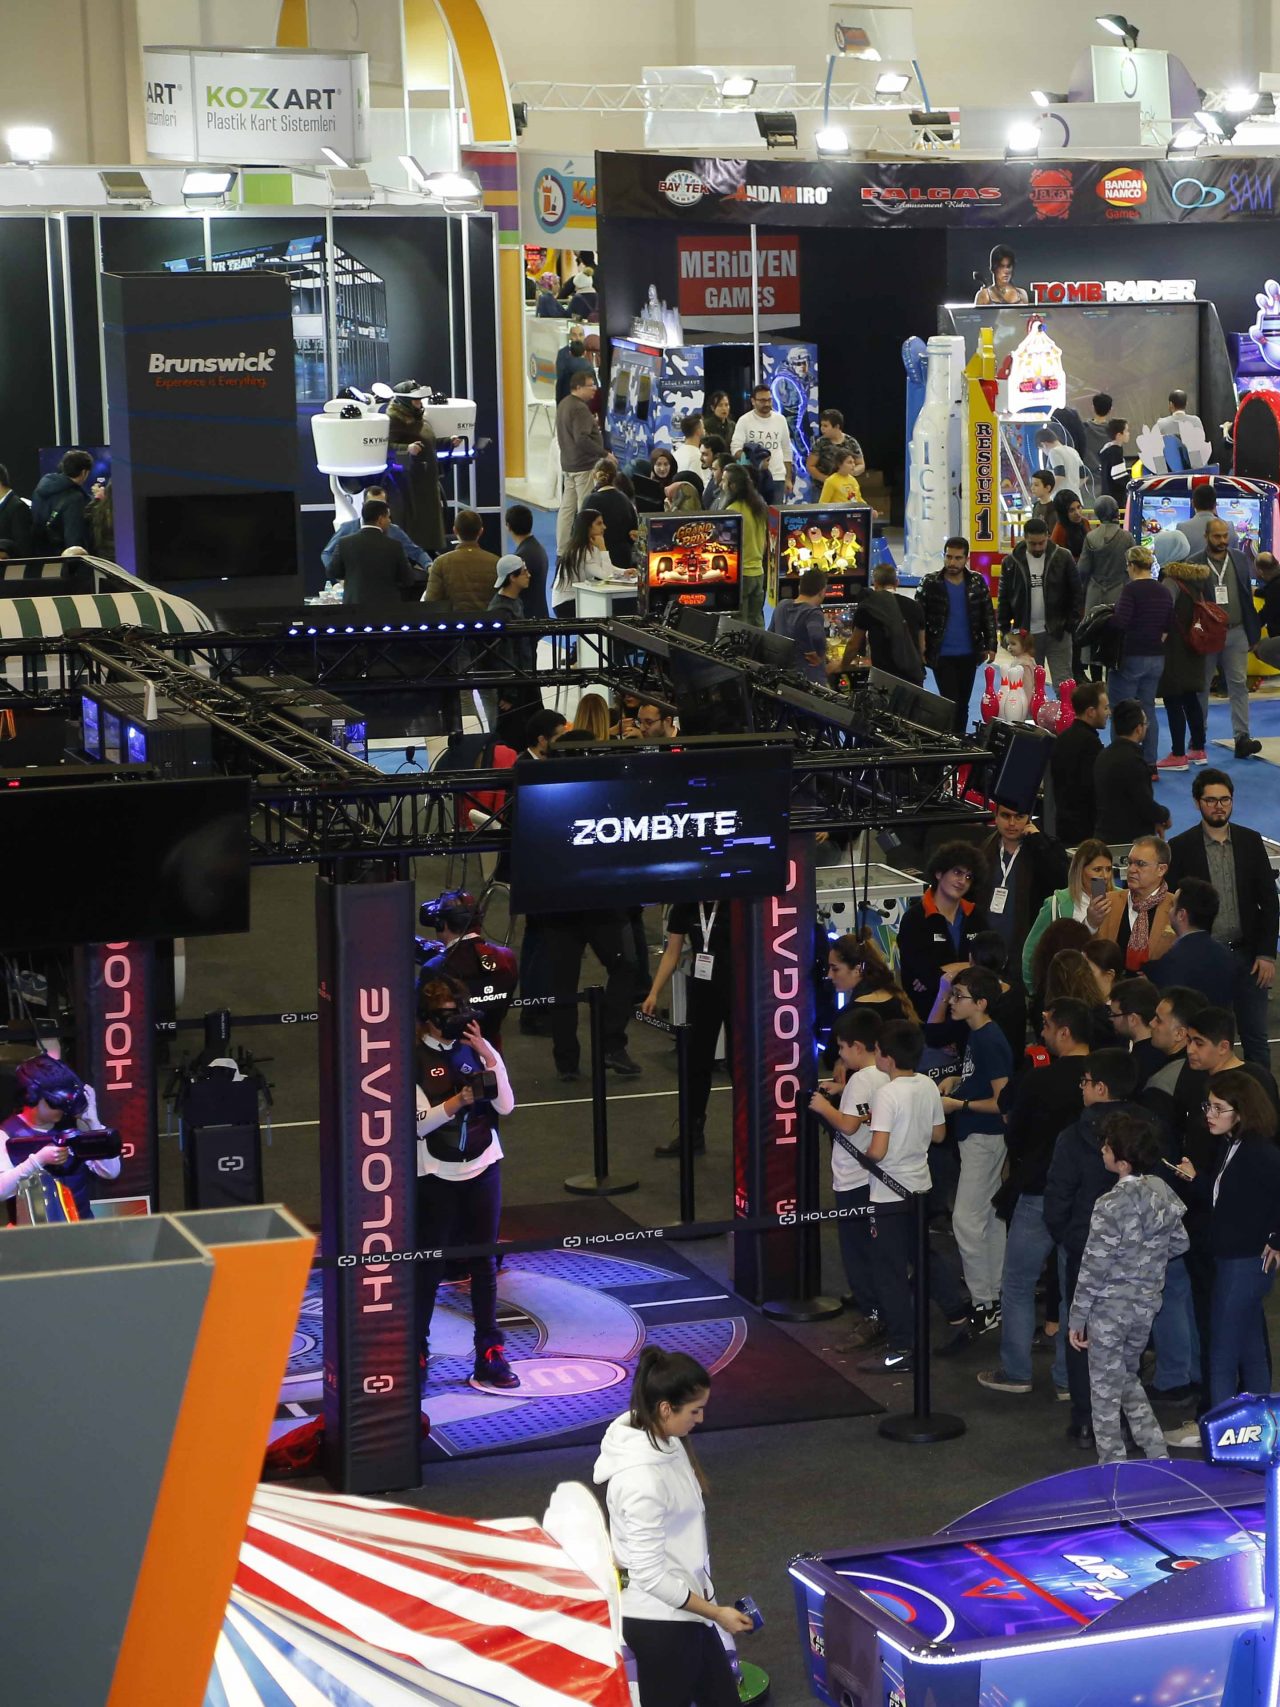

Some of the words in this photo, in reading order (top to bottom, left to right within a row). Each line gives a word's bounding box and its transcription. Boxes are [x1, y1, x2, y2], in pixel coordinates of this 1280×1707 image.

[207, 111, 247, 131] Plastik
[250, 114, 276, 132] Kart
[281, 114, 336, 132] Sistemleri
[658, 180, 681, 192] BAY
[685, 184, 709, 194] TEK
[861, 187, 1001, 200] FALGAS
[1105, 179, 1141, 189] BANDAI
[1228, 175, 1273, 212] SAM
[1105, 189, 1141, 199] NAMCO
[1105, 208, 1140, 219] Games
[705, 286, 775, 308] GAMES
[1032, 282, 1103, 302] TOMB
[1104, 279, 1196, 302] RAIDER
[149, 352, 273, 373] Brunswick
[156, 376, 205, 388] Experience
[749, 430, 779, 439] STAY
[976, 423, 991, 504] RESCUE
[919, 441, 934, 520] ICE
[677, 523, 711, 538] GRAND
[976, 507, 993, 541] 1
[682, 534, 705, 545] PRIX
[573, 811, 738, 845] ZOMBYTE
[359, 986, 394, 1313] HOLOGATE
[800, 1206, 875, 1221] HOLOGATE
[586, 1230, 663, 1244] HOLOGATE
[361, 1250, 443, 1263] HOLOGATE
[1217, 1425, 1263, 1447] AIR
[1062, 1554, 1130, 1581] AIR
[1070, 1582, 1124, 1601] FX
